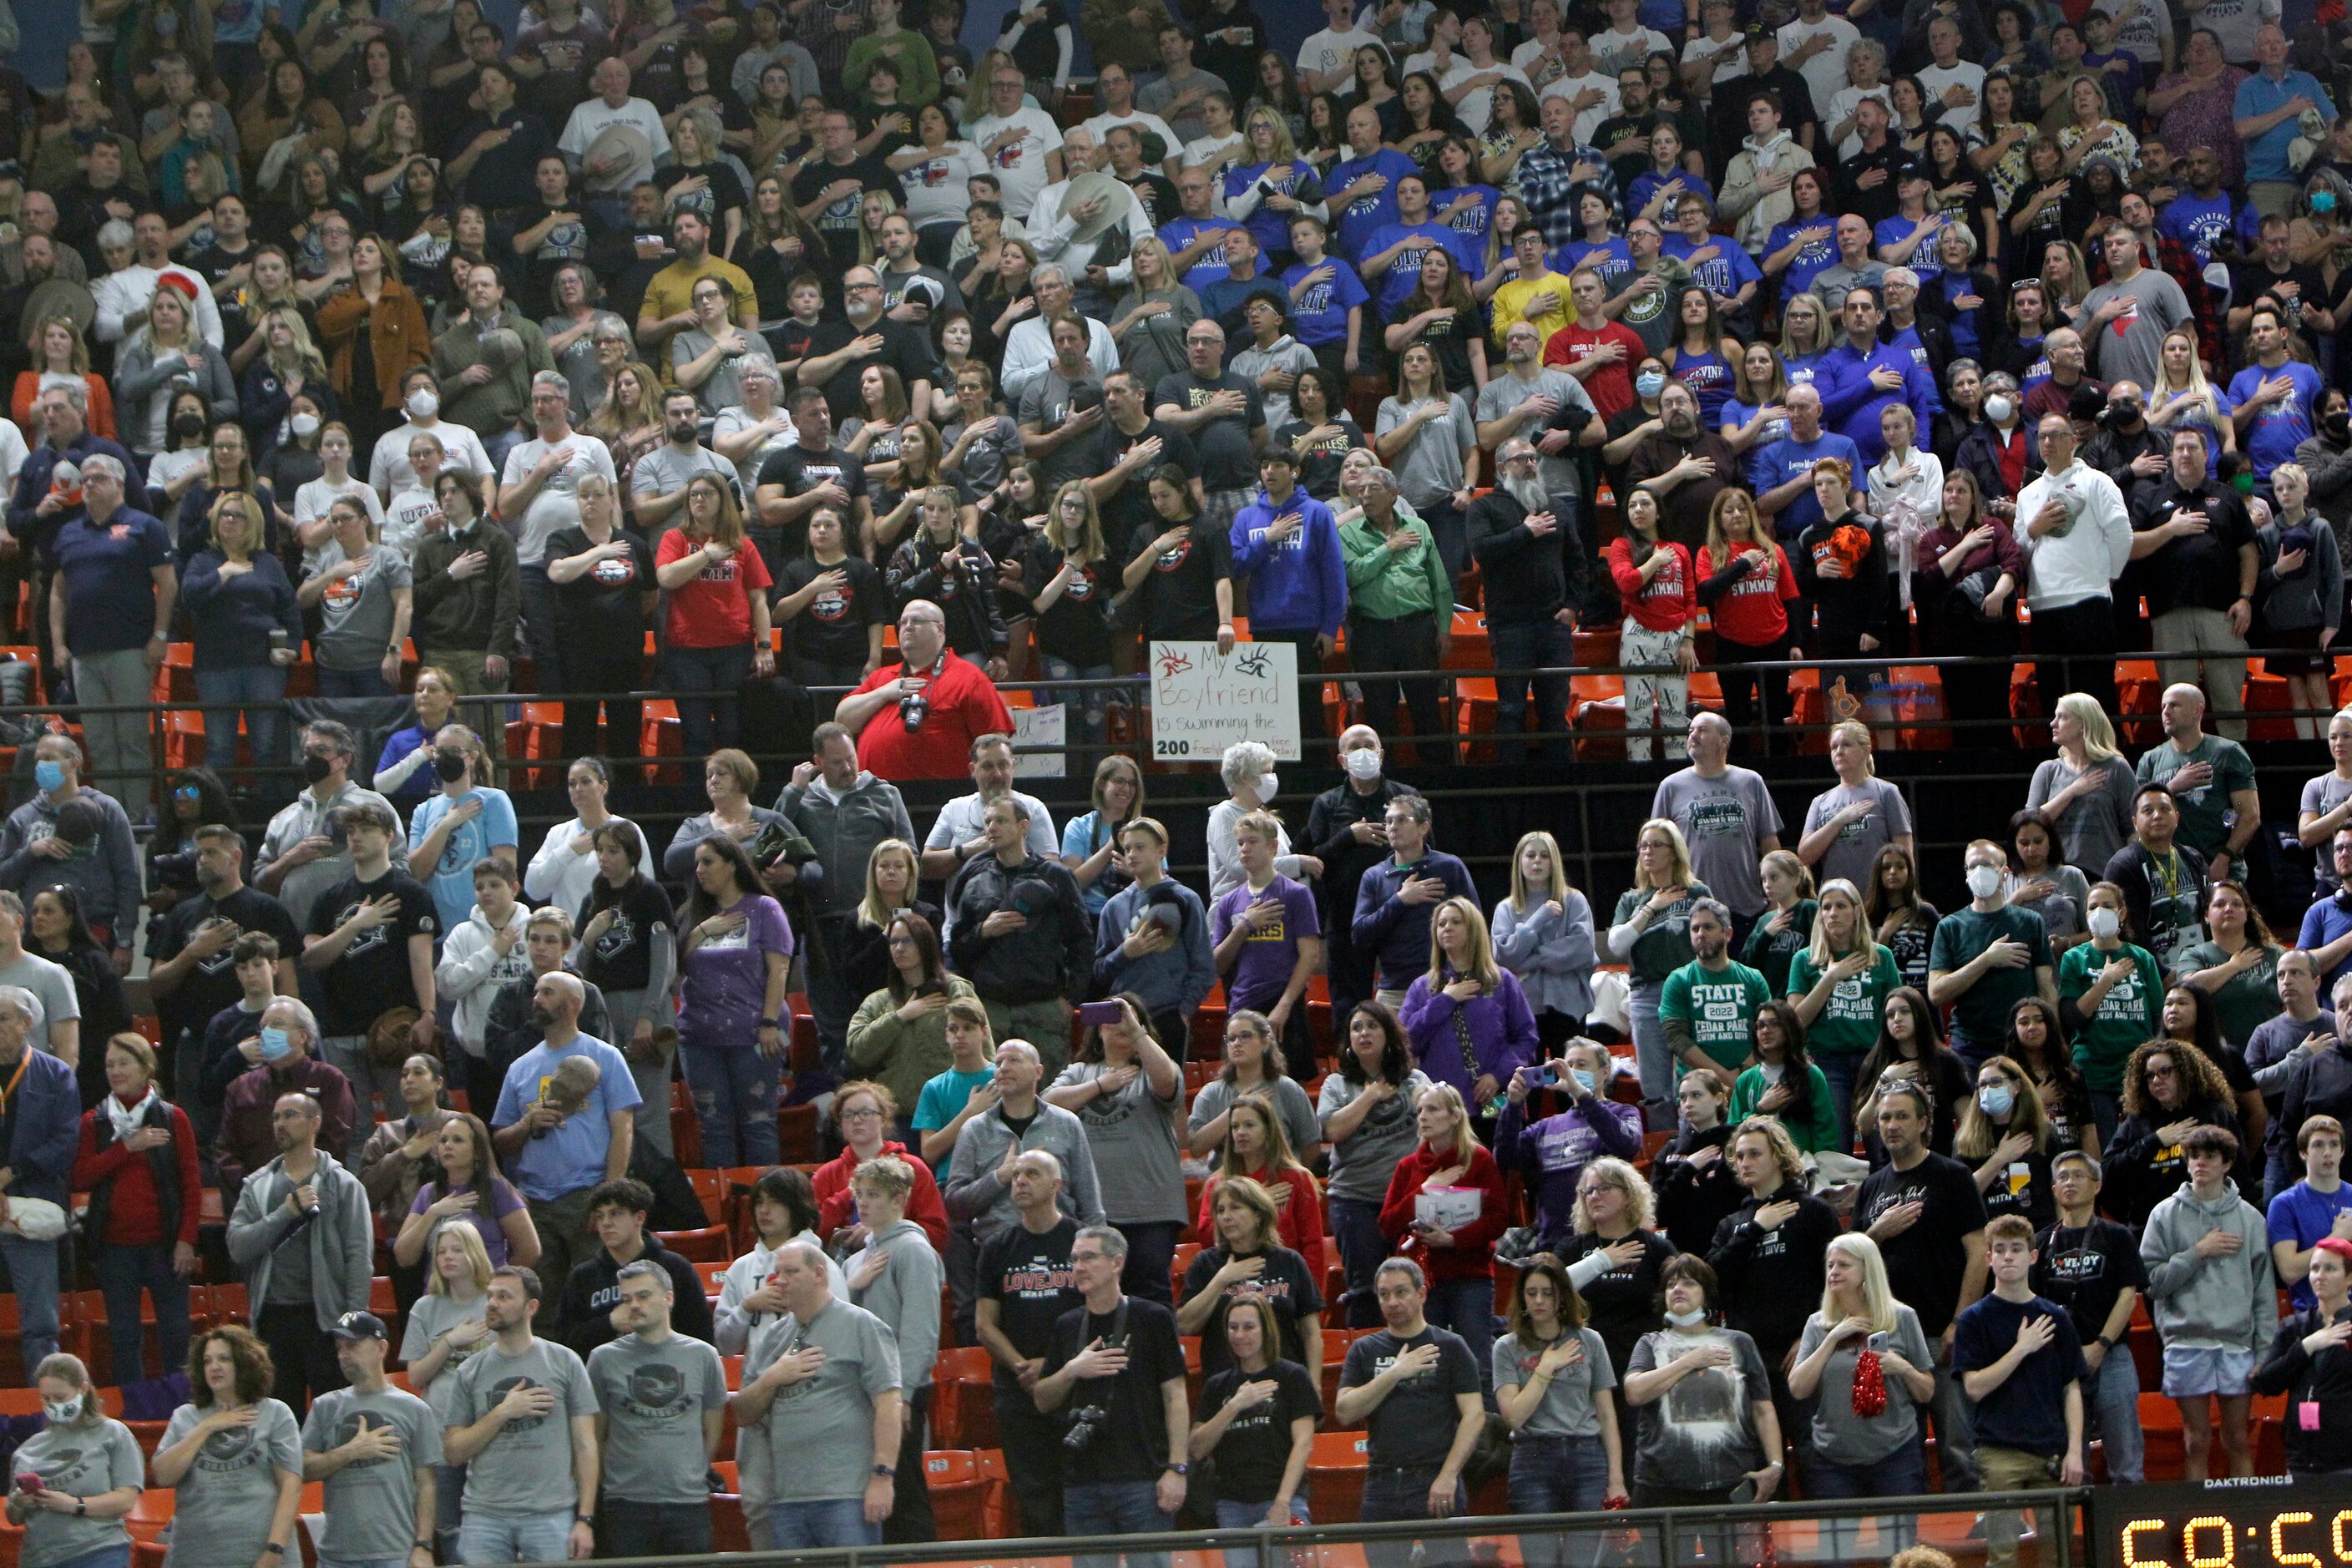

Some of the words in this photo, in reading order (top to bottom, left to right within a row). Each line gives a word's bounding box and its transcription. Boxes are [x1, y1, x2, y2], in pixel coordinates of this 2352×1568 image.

[806, 465, 842, 474] PANTHER
[1201, 645, 1227, 679] My
[1157, 670, 1279, 712] Boyfriend
[1176, 716, 1249, 740] swimming
[1254, 714, 1276, 730] the
[1157, 740, 1190, 755] 200
[1697, 816, 1721, 825] SWIM
[1727, 813, 1746, 823] DIVE
[1691, 983, 1747, 1009] STATE
[1837, 984, 1858, 995] 2022
[1850, 996, 1874, 1010] PARK
[2122, 997, 2145, 1011] PARK
[1709, 1006, 1734, 1017] 2022
[1843, 1010, 1856, 1019] AND
[1857, 1009, 1874, 1019] DIVE
[2115, 1011, 2128, 1019] AND
[2130, 1011, 2145, 1021] DIVE
[1695, 1020, 1726, 1033] CEDAR
[1727, 1019, 1748, 1032] PARK
[1697, 1032, 1716, 1042] SWIM
[1717, 1032, 1733, 1041] AND
[1734, 1031, 1748, 1041] DIVE
[1874, 1190, 1903, 1207] Senior
[1905, 1184, 1926, 1201] Dad
[1988, 1194, 2011, 1205] WITH
[1765, 1242, 1786, 1255] DIVE
[1004, 1271, 1075, 1293] LOVEJOY
[1611, 1272, 1634, 1280] DIVE
[1019, 1289, 1036, 1299] SWIM
[1043, 1287, 1059, 1297] DIVE
[2203, 1474, 2294, 1490] DAKTRONICS
